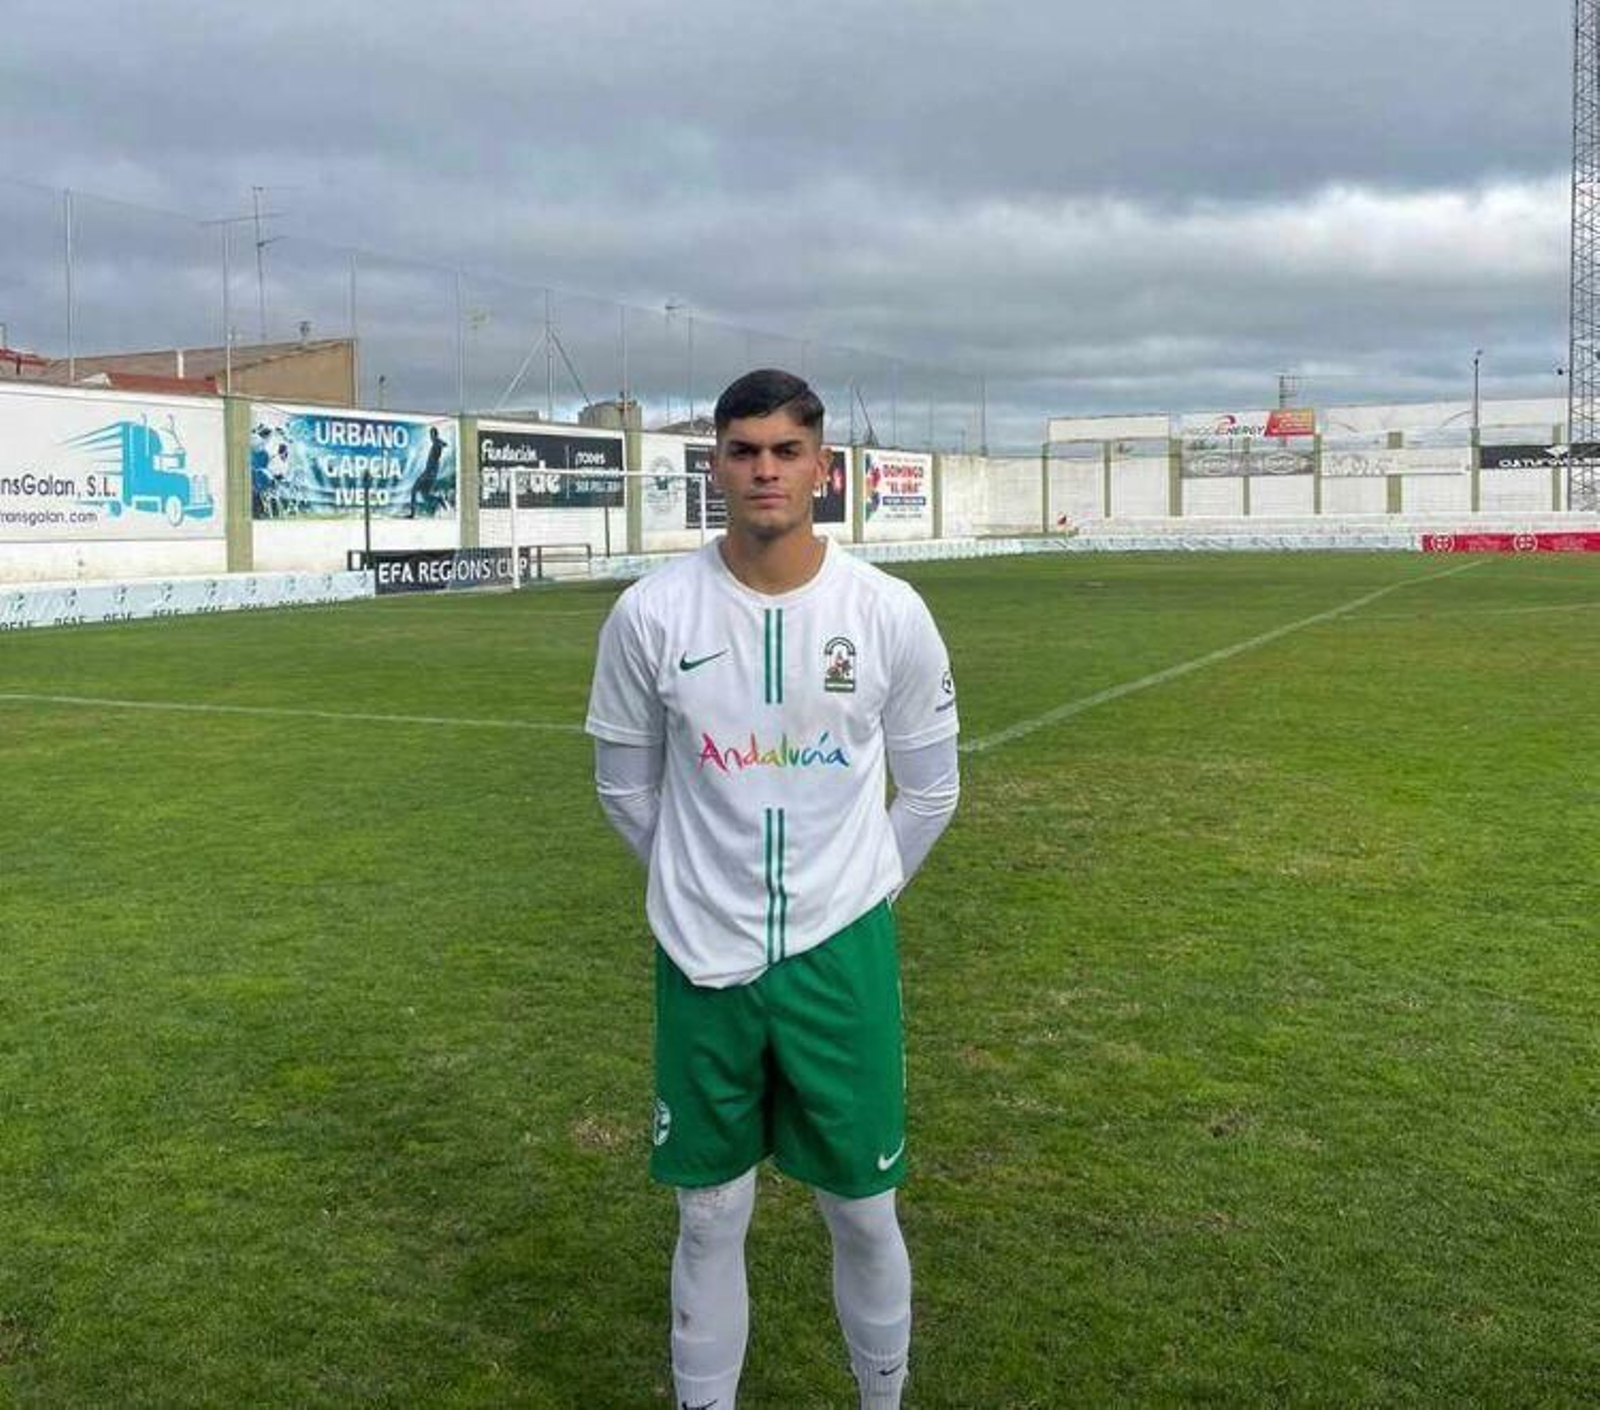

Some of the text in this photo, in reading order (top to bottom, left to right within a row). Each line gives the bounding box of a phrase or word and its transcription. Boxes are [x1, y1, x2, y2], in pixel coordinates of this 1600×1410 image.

[316, 421, 408, 449] URBANO
[87, 474, 116, 497] S.L.
[335, 488, 389, 506] IVECO
[377, 562, 414, 583] EFA
[699, 732, 849, 773] Andalucía
